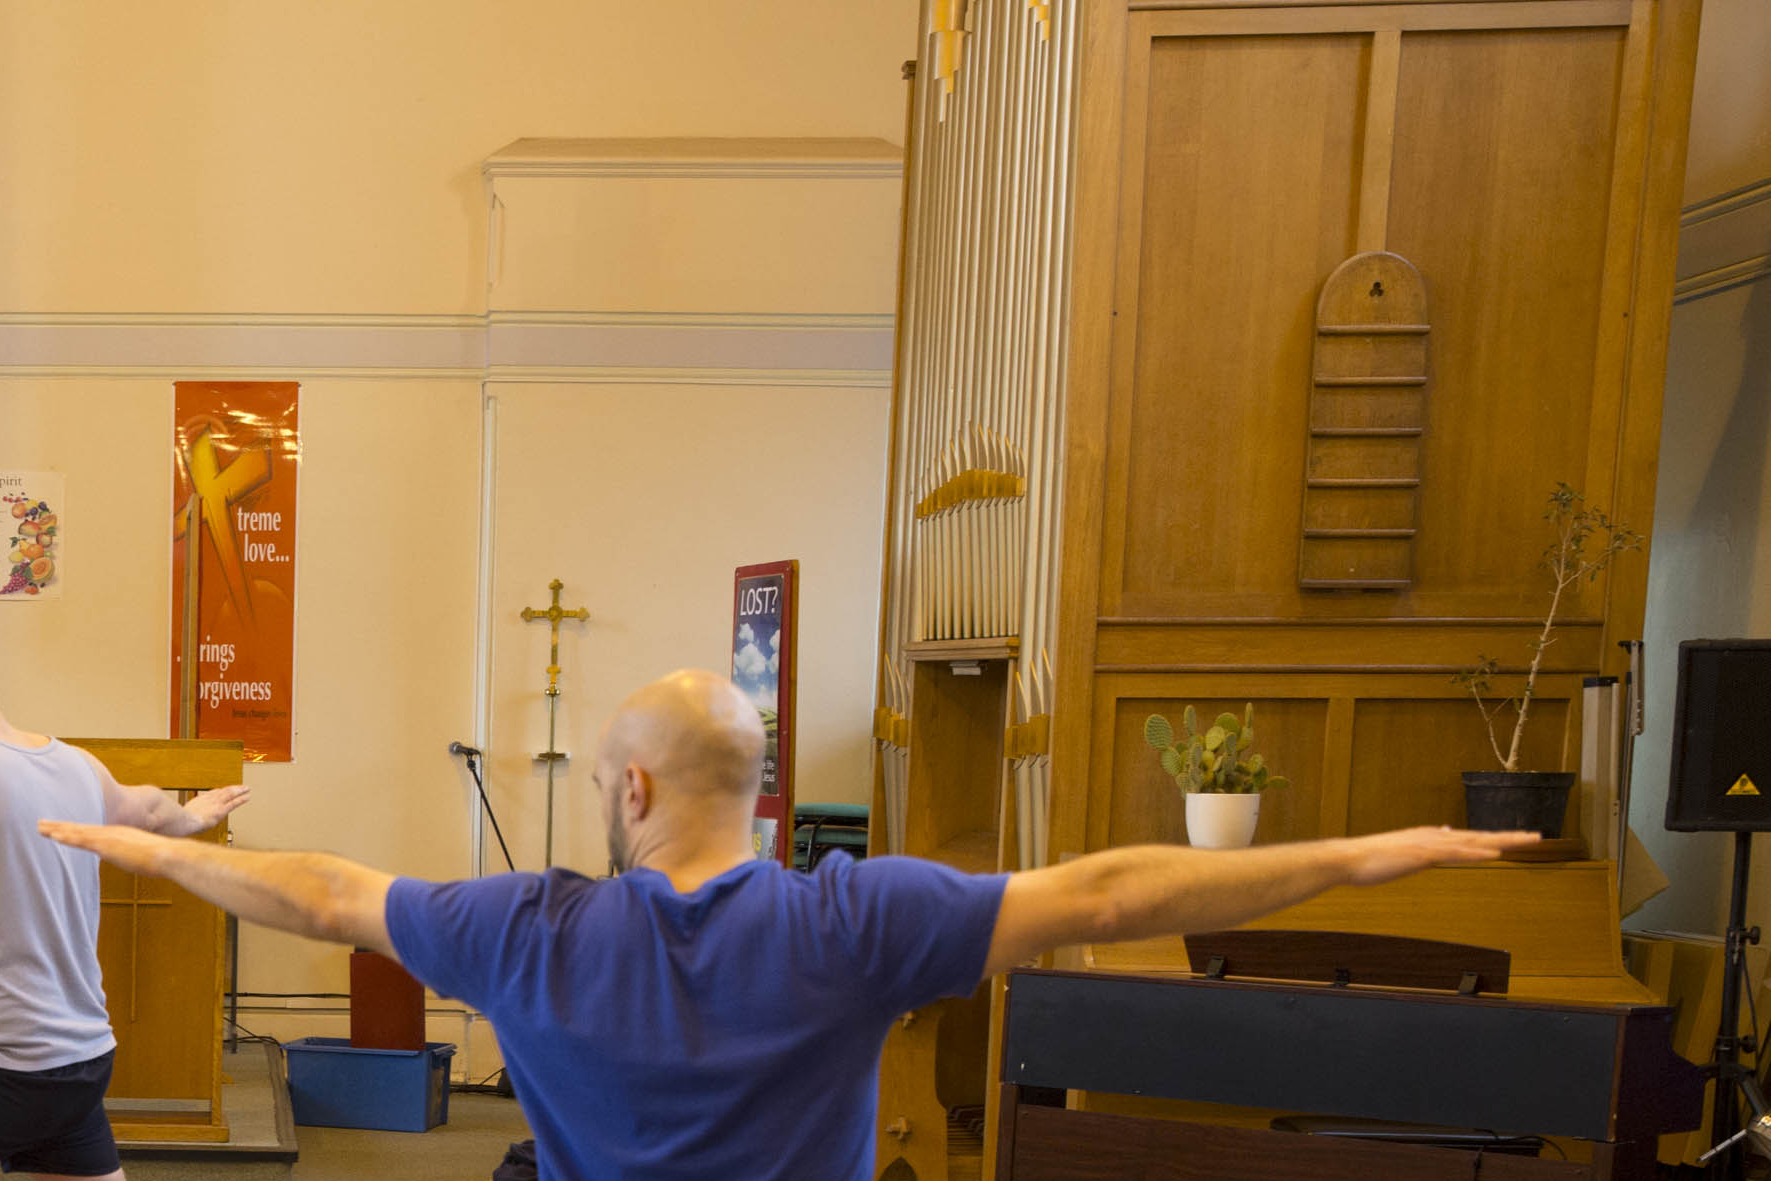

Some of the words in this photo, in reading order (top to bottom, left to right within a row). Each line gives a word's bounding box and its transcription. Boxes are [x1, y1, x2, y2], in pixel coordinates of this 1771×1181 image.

[244, 533, 290, 562] love...
[740, 586, 779, 616] LOST?
[199, 634, 236, 671] rings
[199, 672, 272, 709] orgiveness
